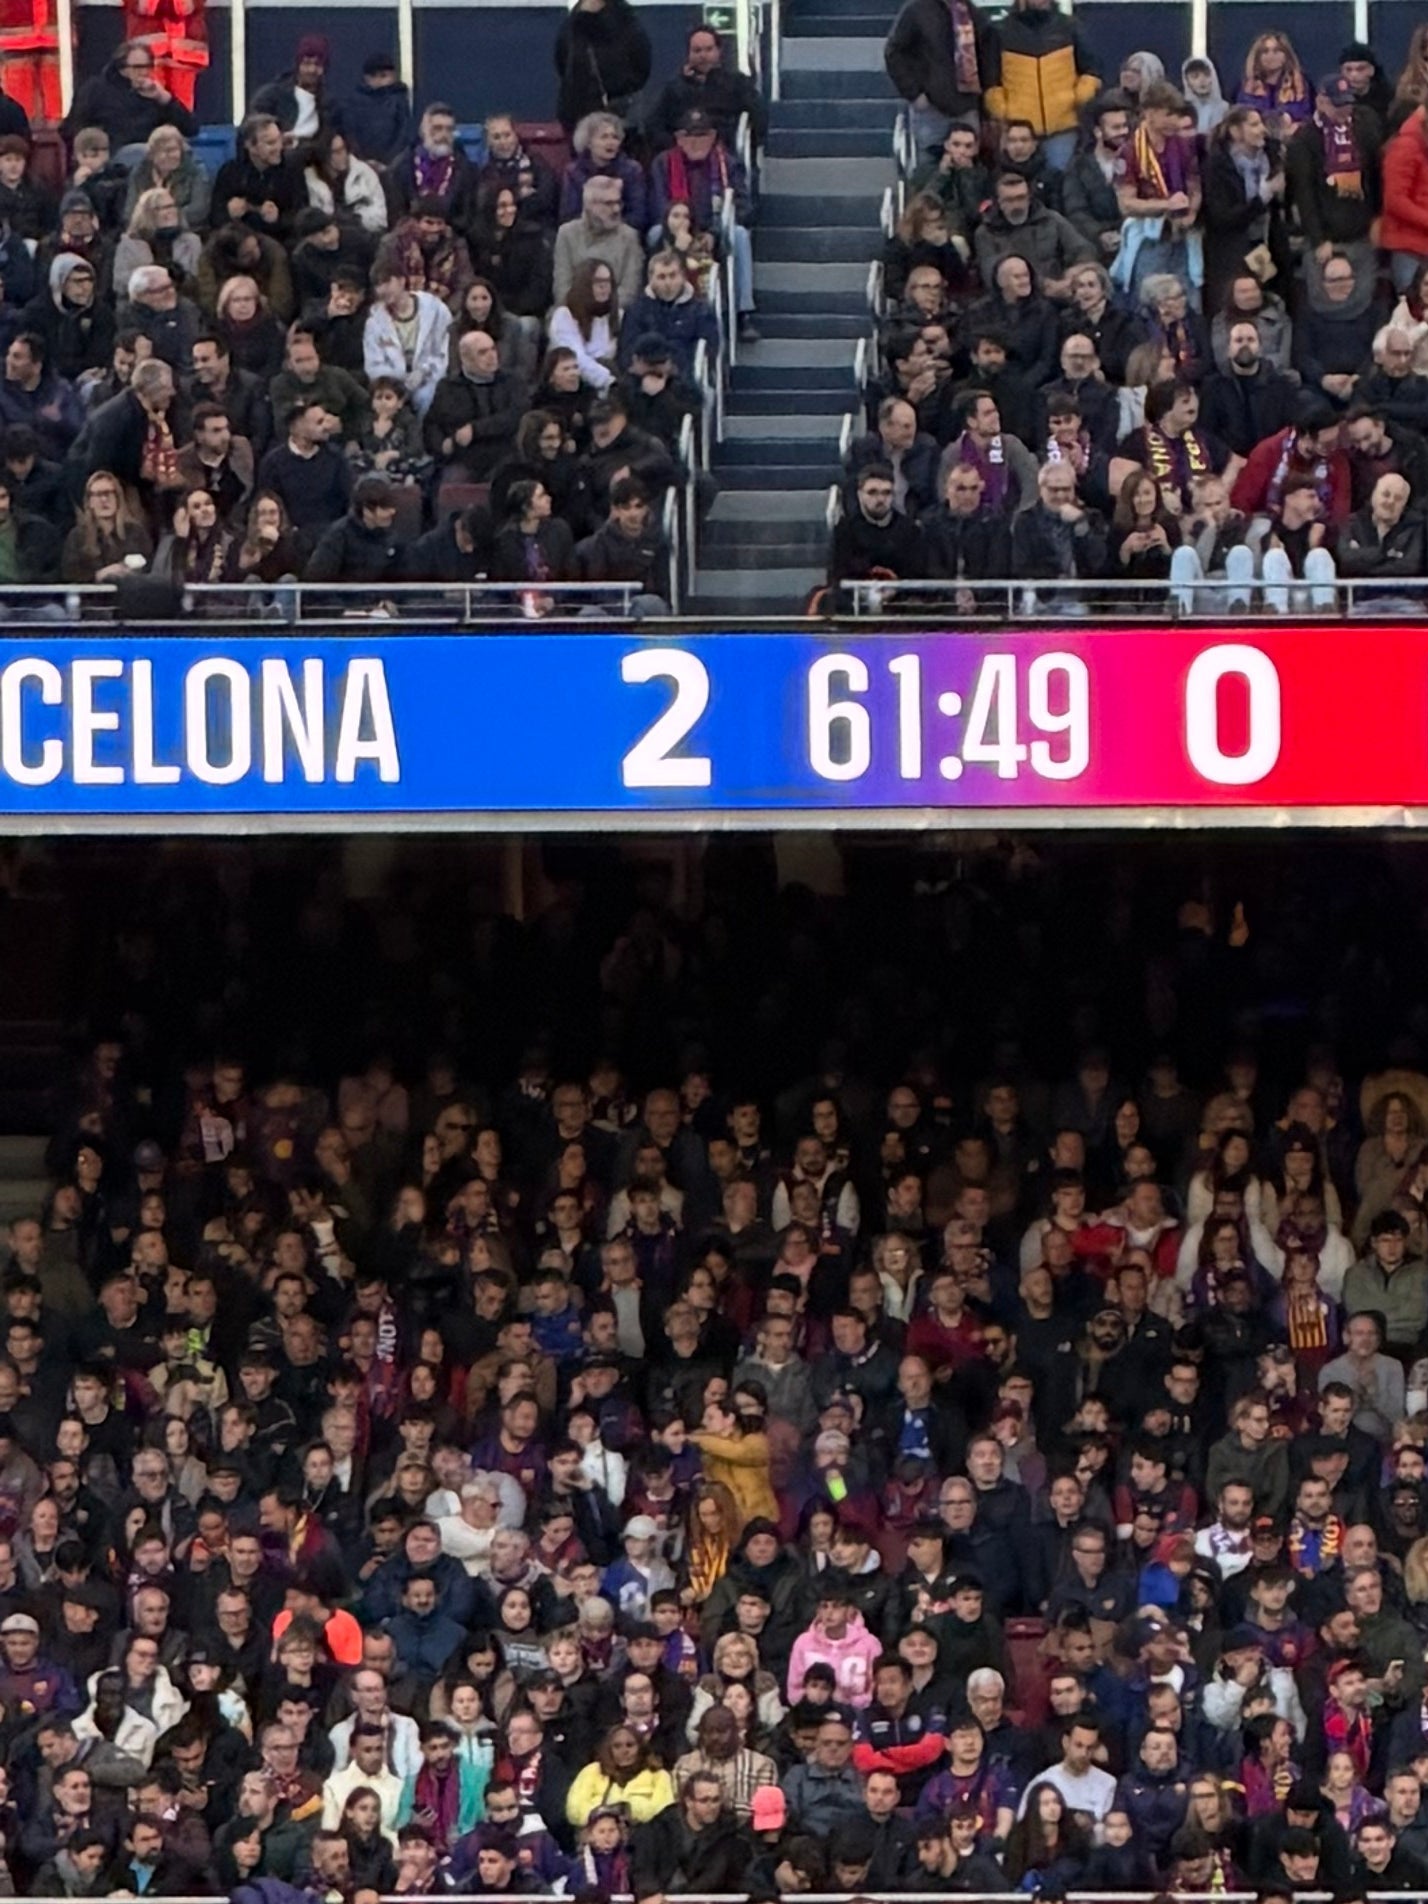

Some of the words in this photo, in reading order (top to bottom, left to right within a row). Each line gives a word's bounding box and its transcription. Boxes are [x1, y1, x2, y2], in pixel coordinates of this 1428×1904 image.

[1, 658, 399, 784] CELONA
[622, 649, 710, 786] 2
[809, 653, 1088, 780] 61:49
[1187, 645, 1279, 783] 0
